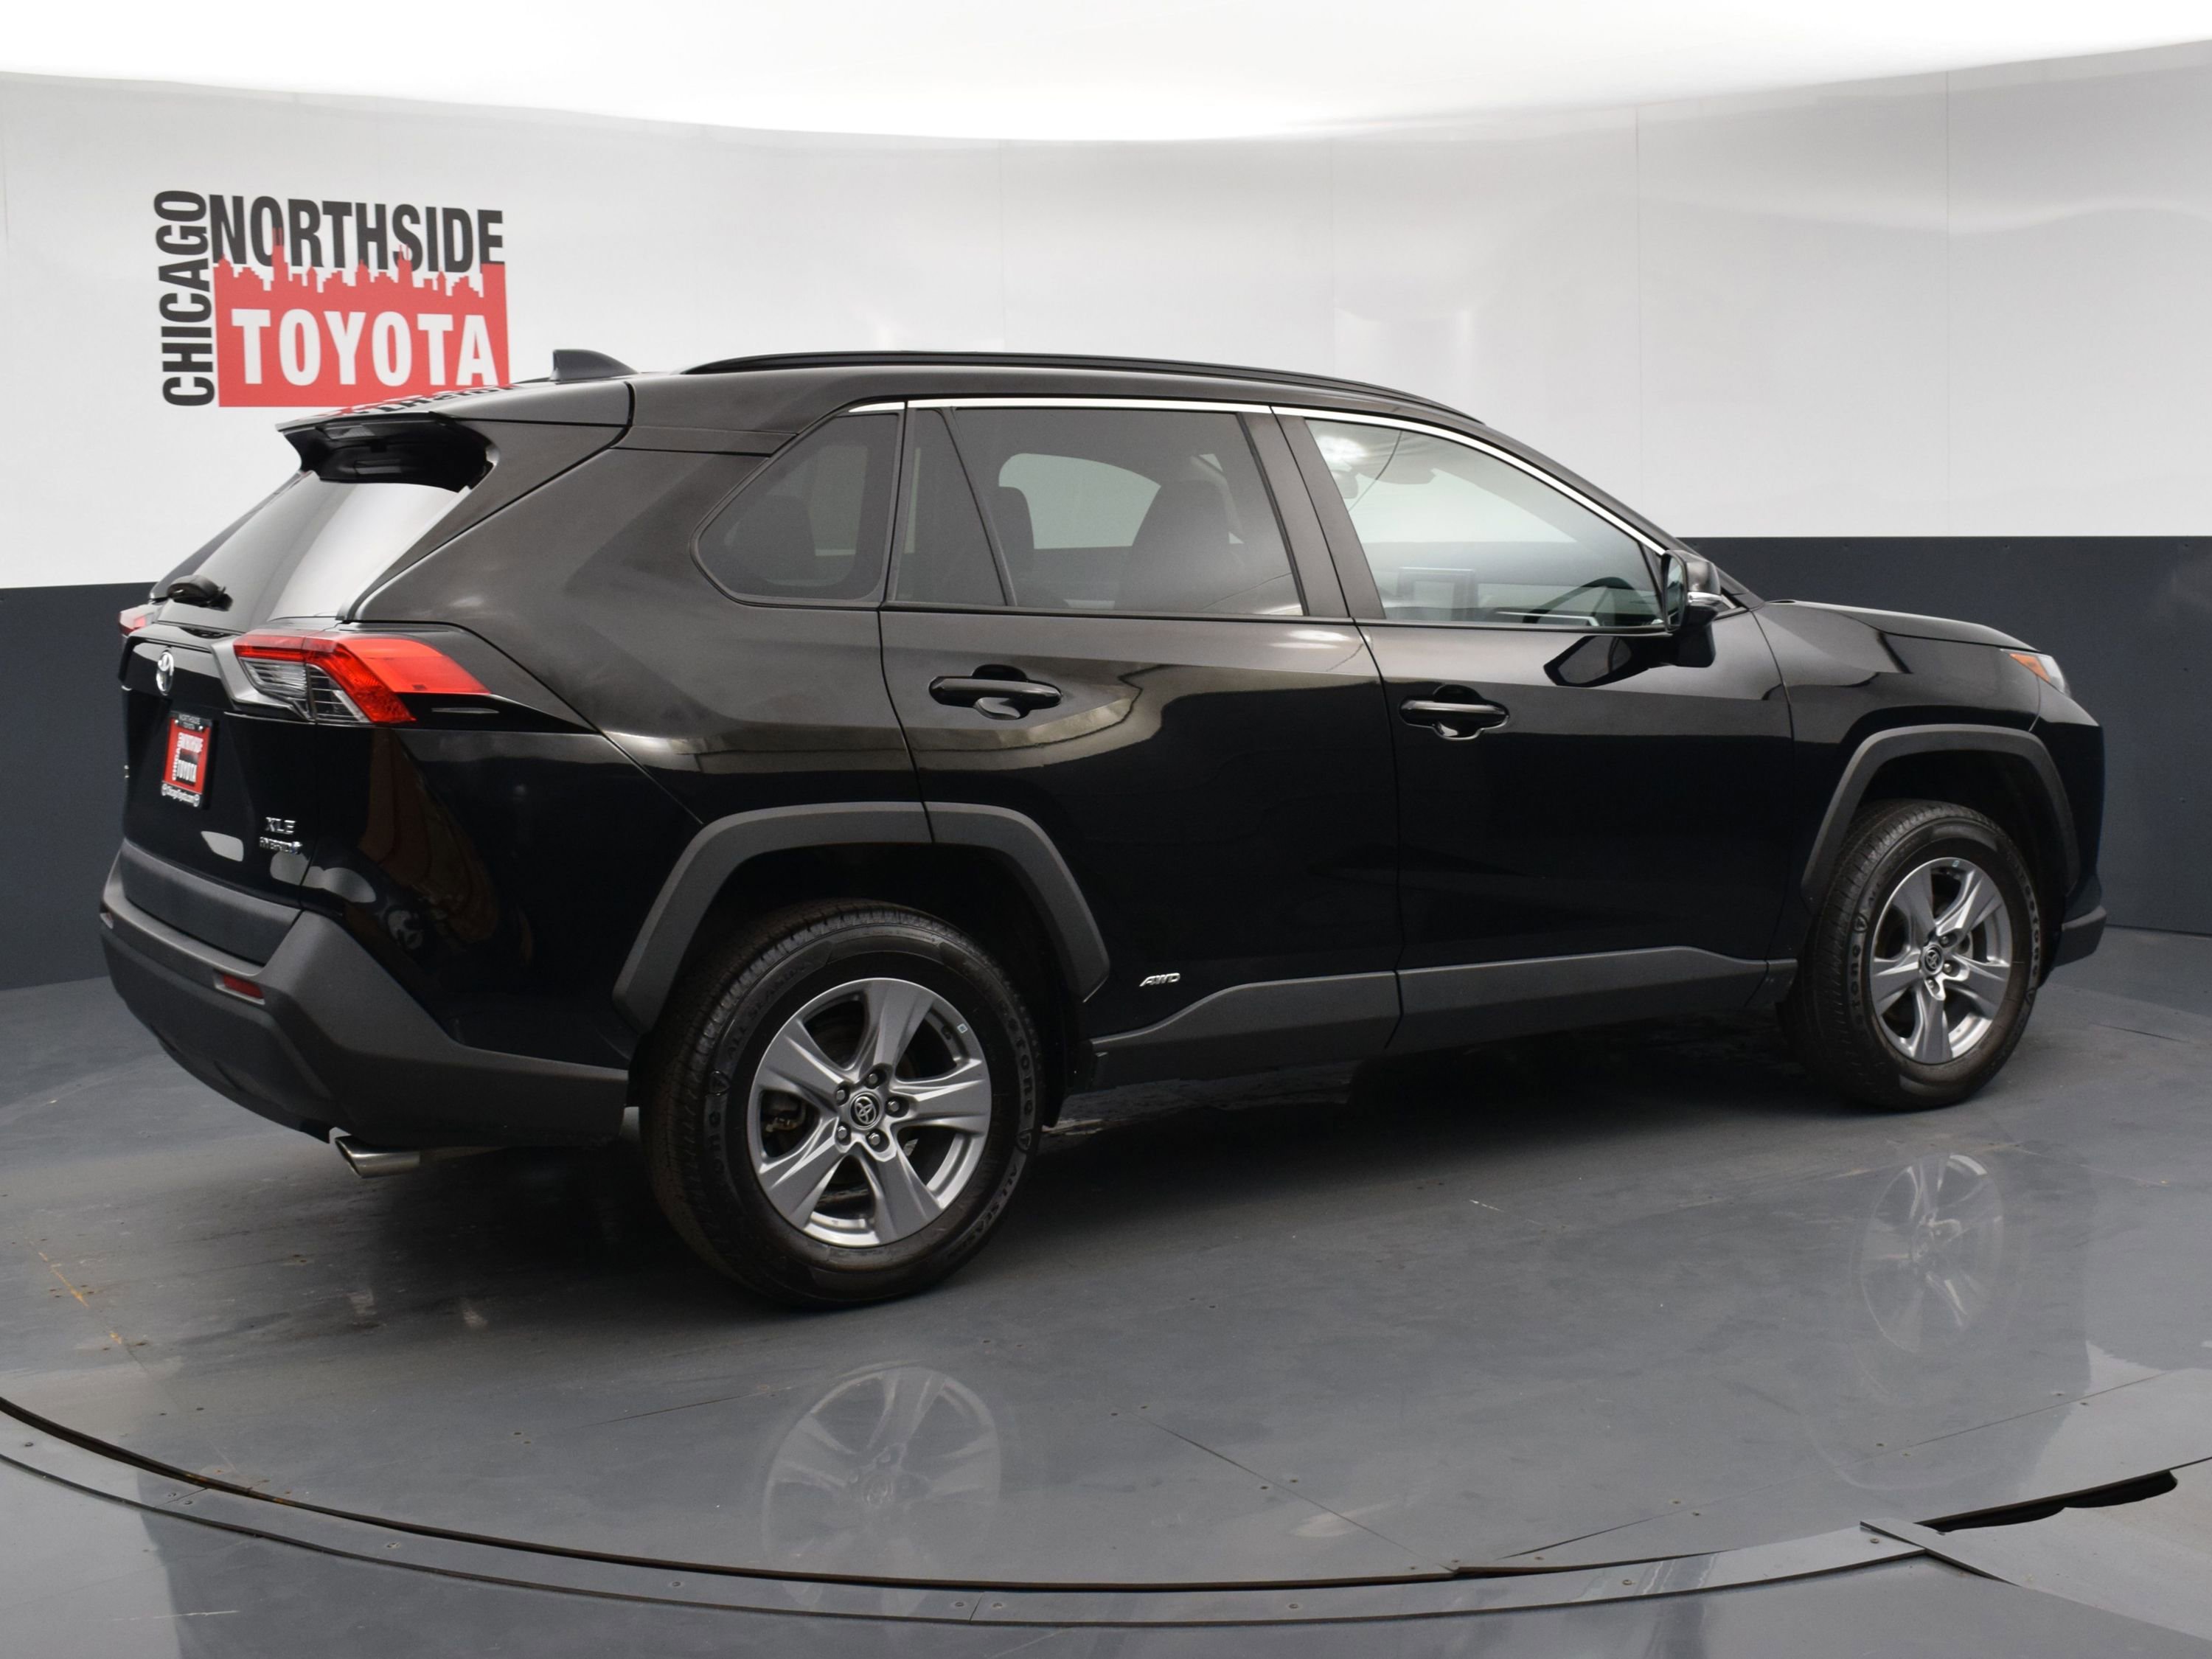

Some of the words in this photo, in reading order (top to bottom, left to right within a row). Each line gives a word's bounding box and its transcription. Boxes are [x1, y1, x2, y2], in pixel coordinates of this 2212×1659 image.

[209, 194, 504, 274] NORTHSIDE
[154, 190, 215, 406] CHICAGO
[232, 308, 498, 386] TOYOTA
[265, 817, 296, 834] XLE
[1139, 973, 1180, 987] AWD
